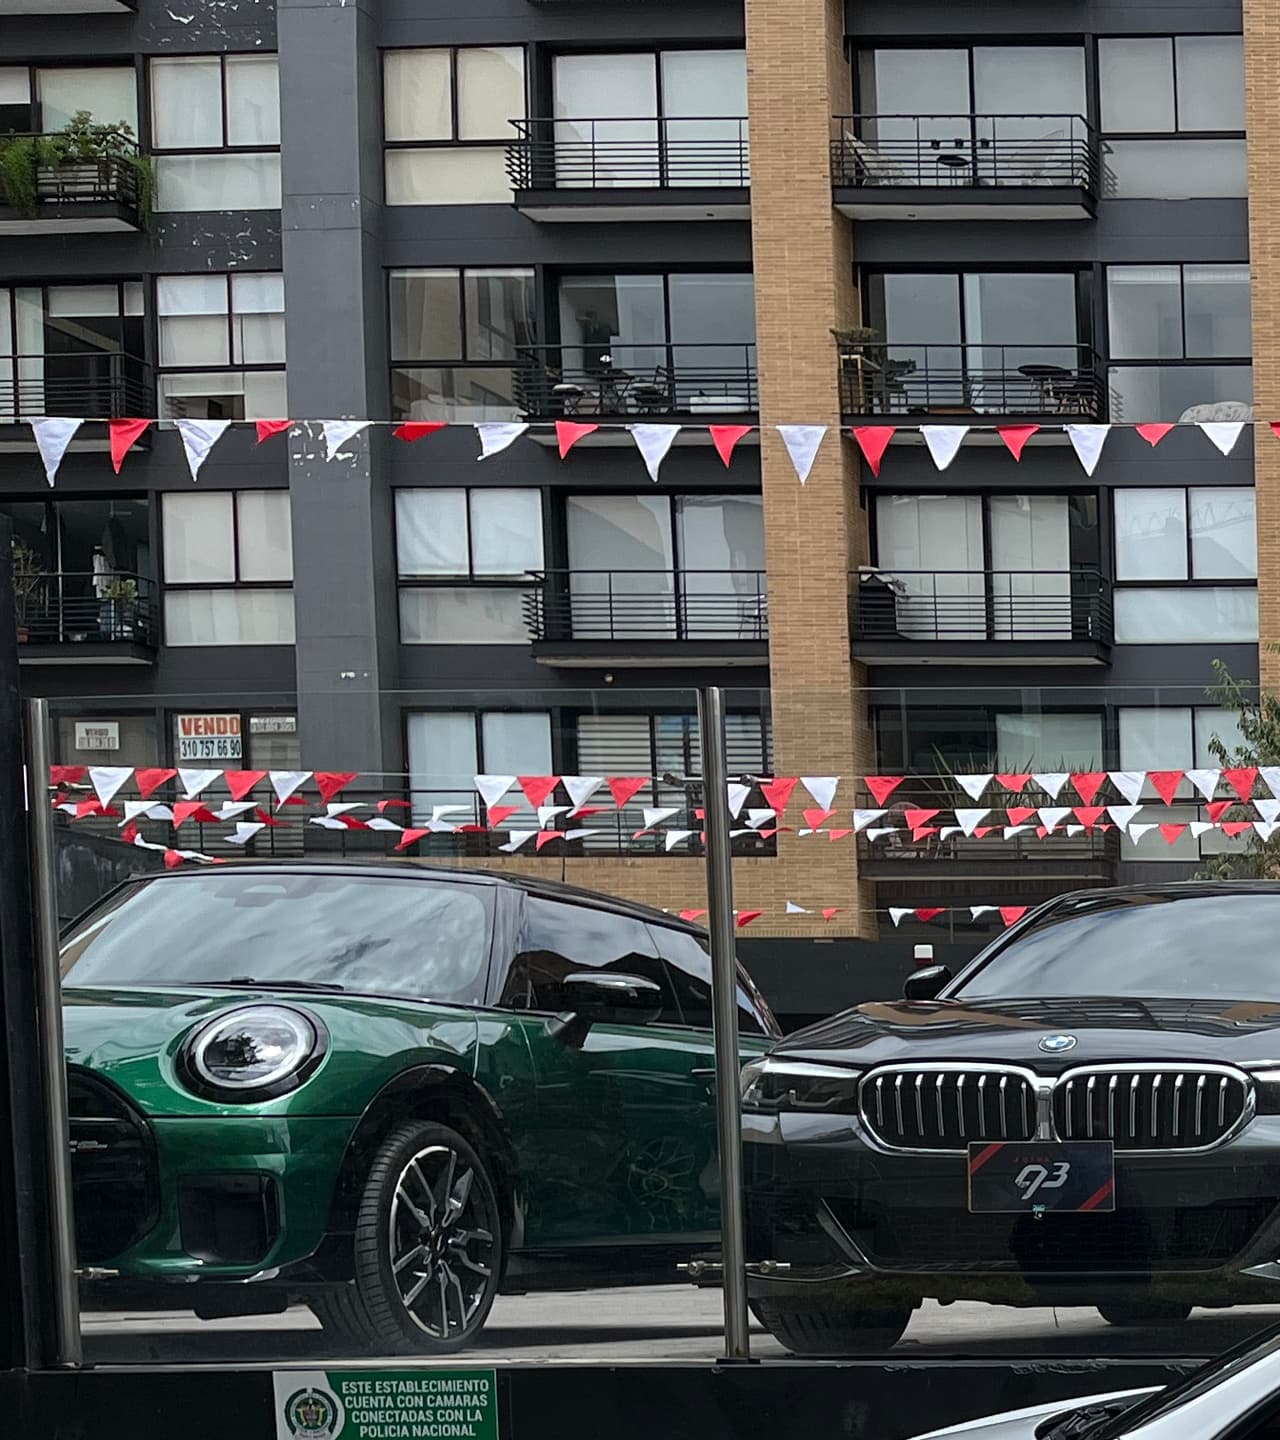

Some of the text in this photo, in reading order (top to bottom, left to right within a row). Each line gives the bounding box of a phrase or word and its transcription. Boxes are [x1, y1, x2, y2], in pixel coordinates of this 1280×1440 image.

[181, 716, 241, 736] VENDO
[182, 739, 241, 757] 310 757 66 90
[1014, 1161, 1071, 1200] 93
[342, 1379, 489, 1394] ESTE ESTABLECIMIENTO
[345, 1394, 488, 1409] CUENTA CON CAMARAS
[352, 1409, 482, 1423] CONECTADAS CON LA
[360, 1424, 476, 1438] POLICIA NACIONAL
